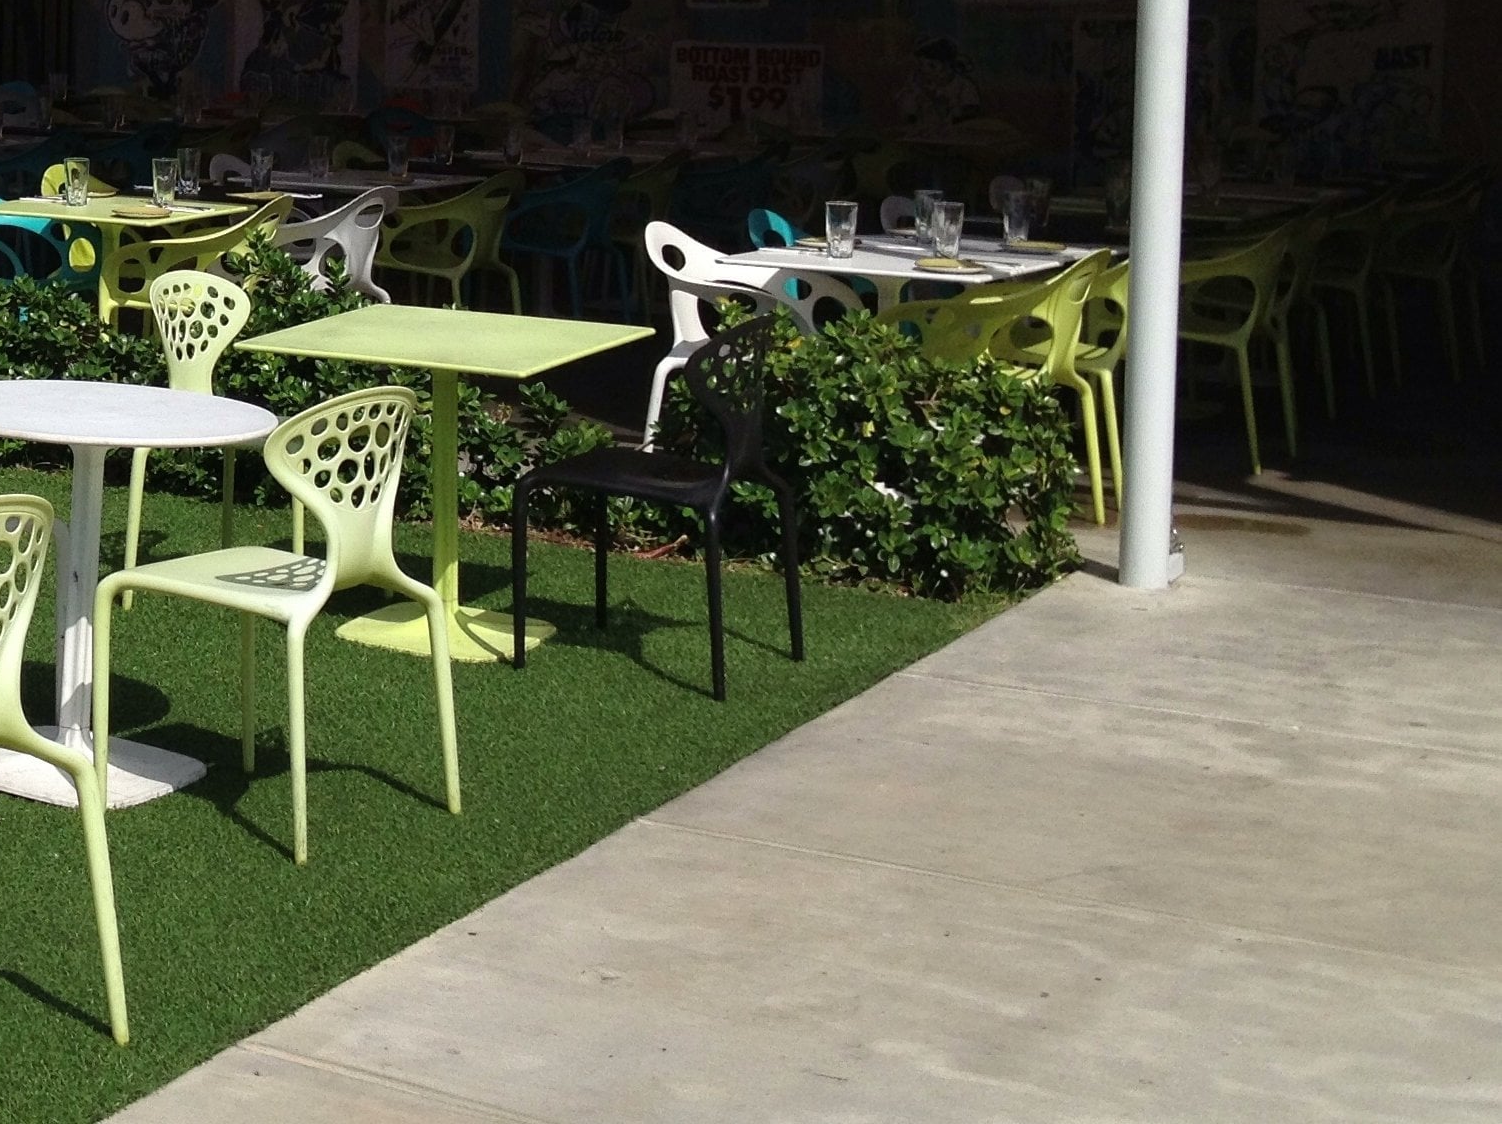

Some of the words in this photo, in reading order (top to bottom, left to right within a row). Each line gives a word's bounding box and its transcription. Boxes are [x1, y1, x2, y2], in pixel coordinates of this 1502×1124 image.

[676, 46, 750, 65] BOTTOM
[755, 48, 822, 67] ROUND
[691, 64, 751, 83] ROAST
